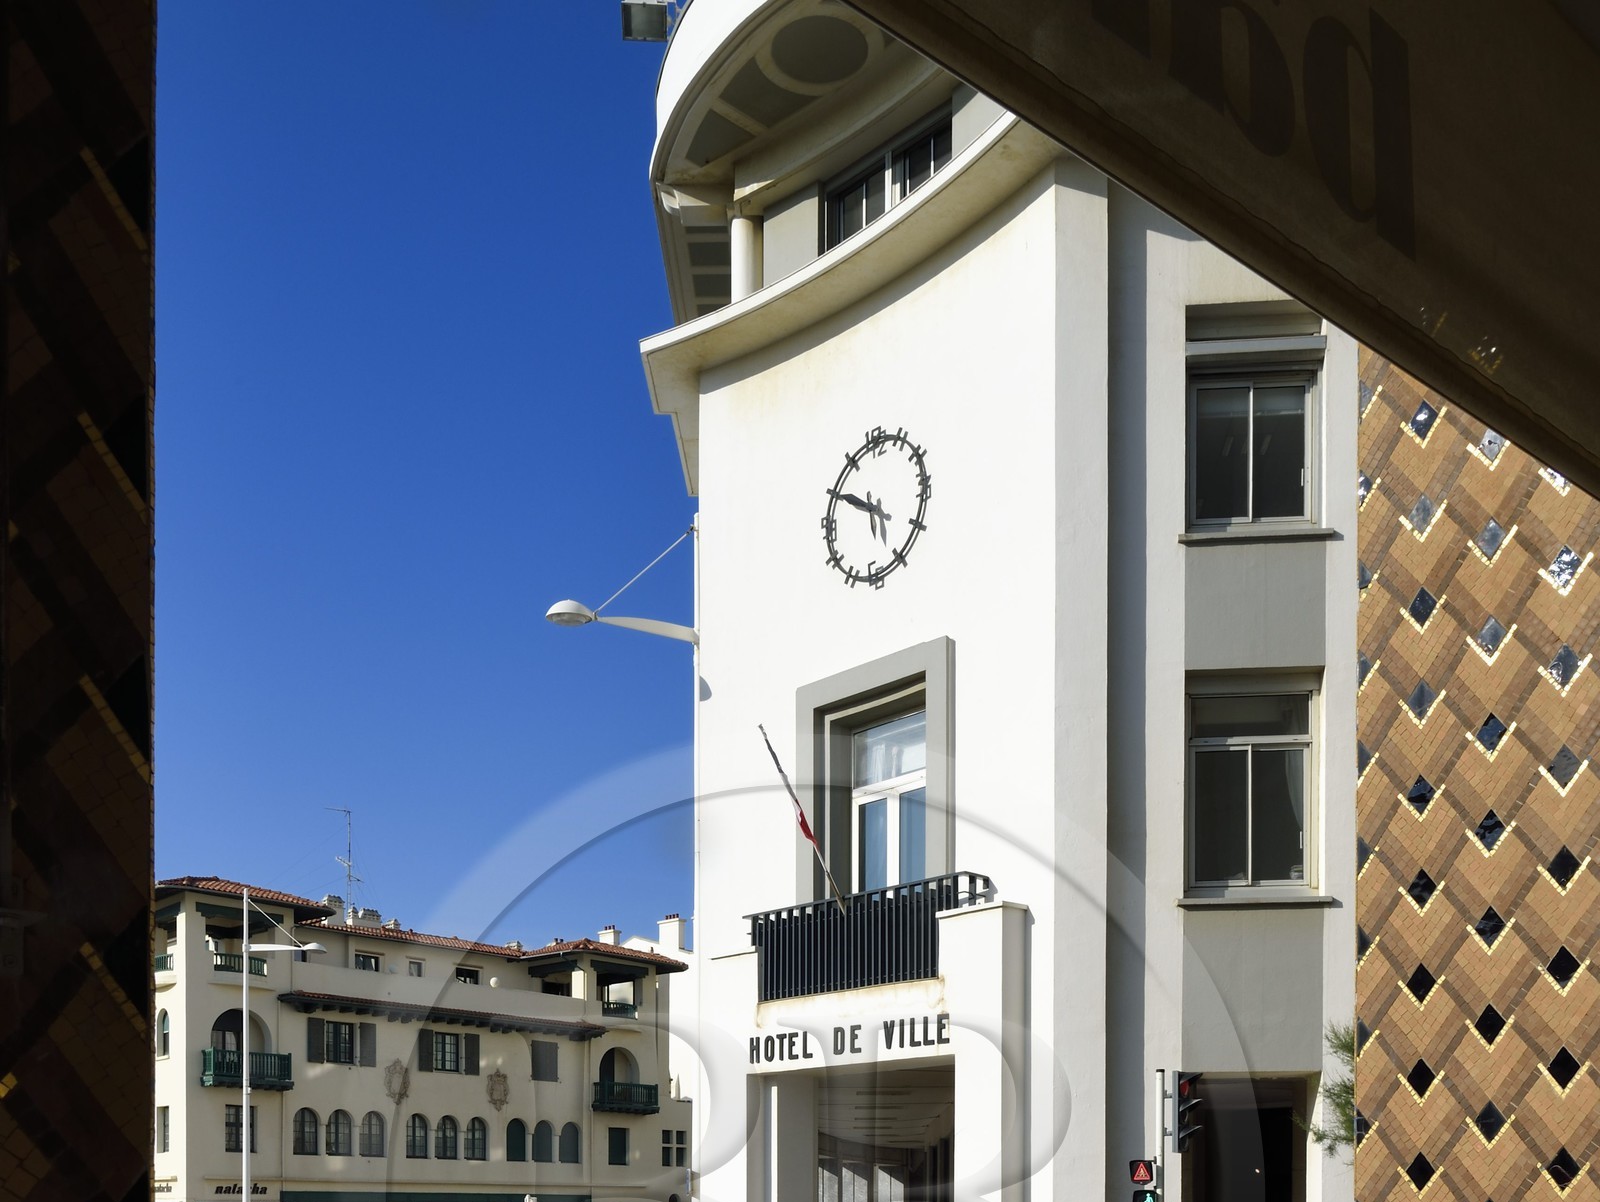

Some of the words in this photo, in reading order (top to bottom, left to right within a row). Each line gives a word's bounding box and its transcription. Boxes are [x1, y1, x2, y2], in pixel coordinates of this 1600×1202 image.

[749, 1031, 813, 1064] HOTEL
[833, 1024, 862, 1055] DE
[883, 1013, 950, 1050] VILLE
[214, 1183, 268, 1195] nataha
